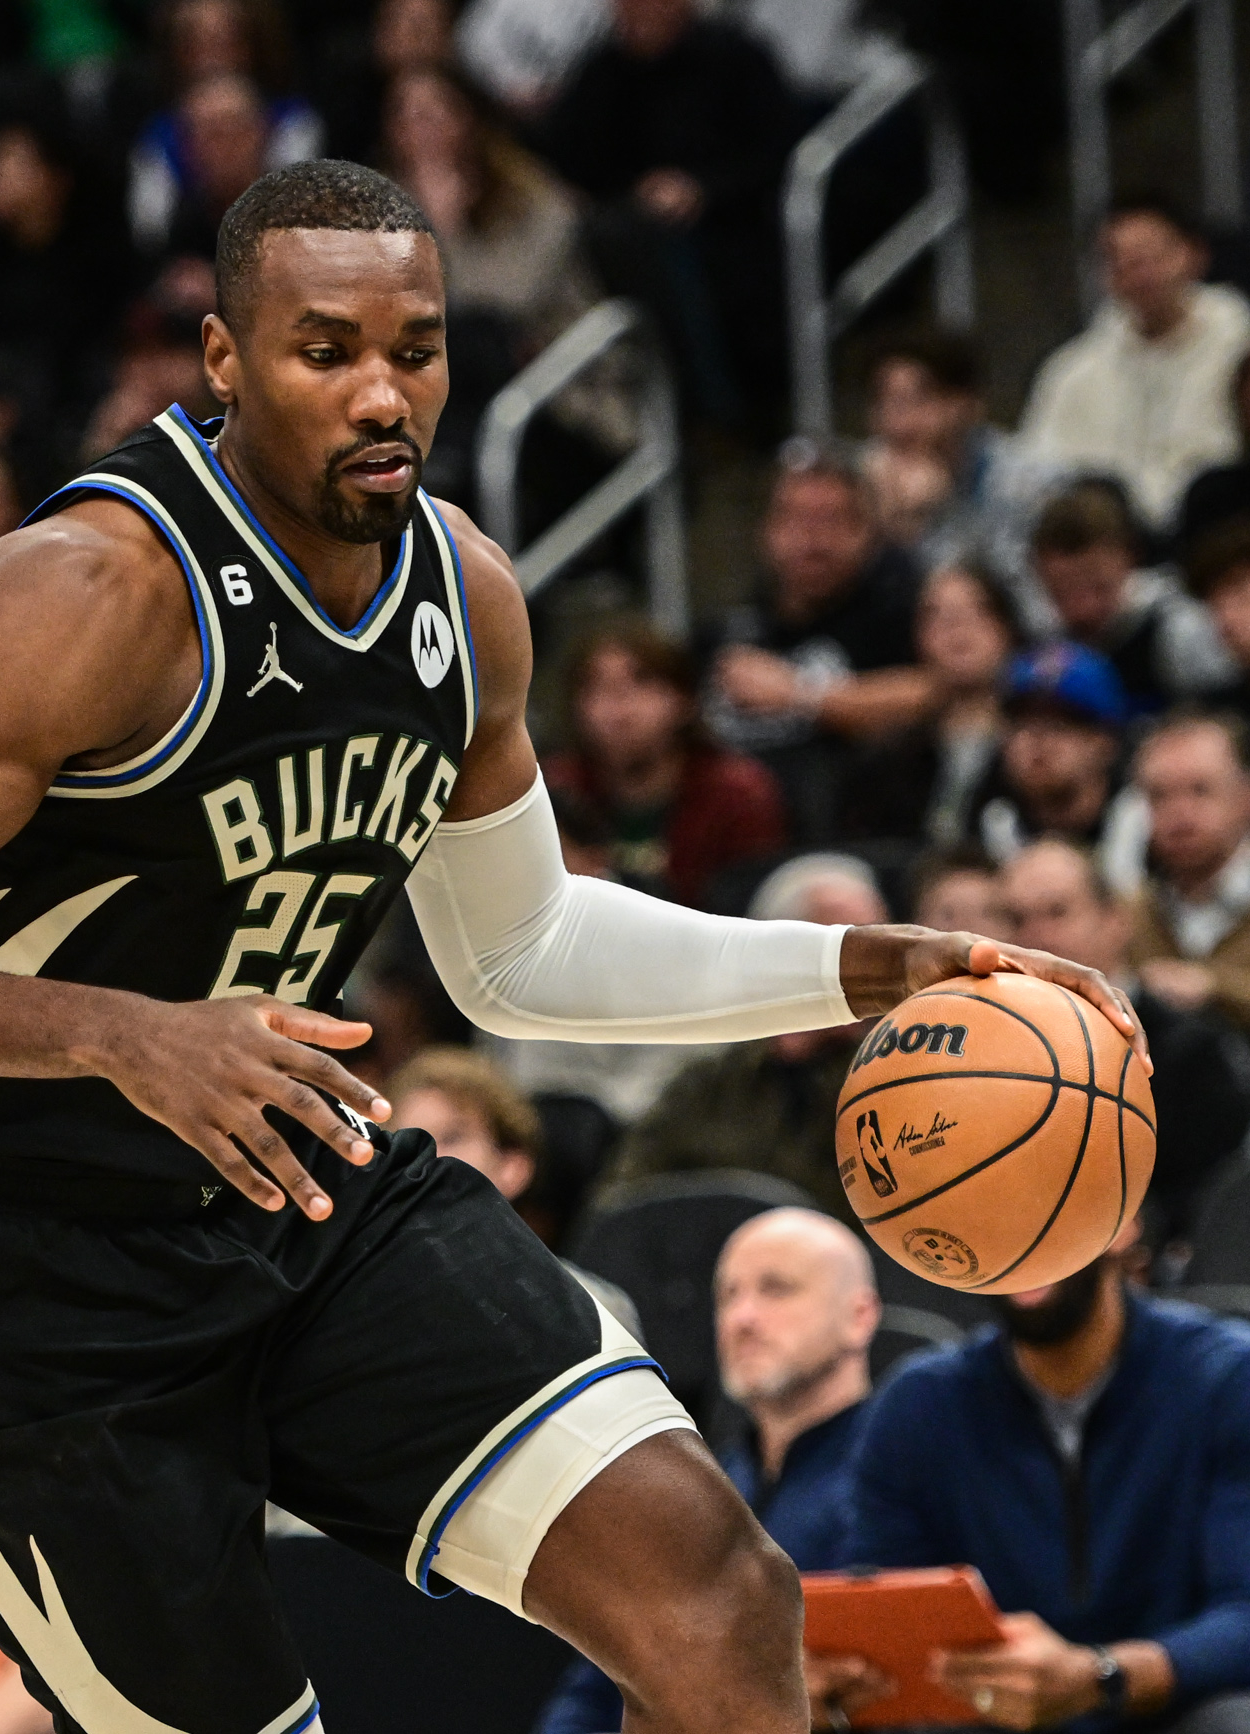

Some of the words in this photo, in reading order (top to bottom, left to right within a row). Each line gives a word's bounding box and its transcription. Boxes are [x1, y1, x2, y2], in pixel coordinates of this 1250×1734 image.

[219, 564, 254, 606] 6
[199, 733, 459, 884] BUCKS
[205, 870, 382, 1006] 25
